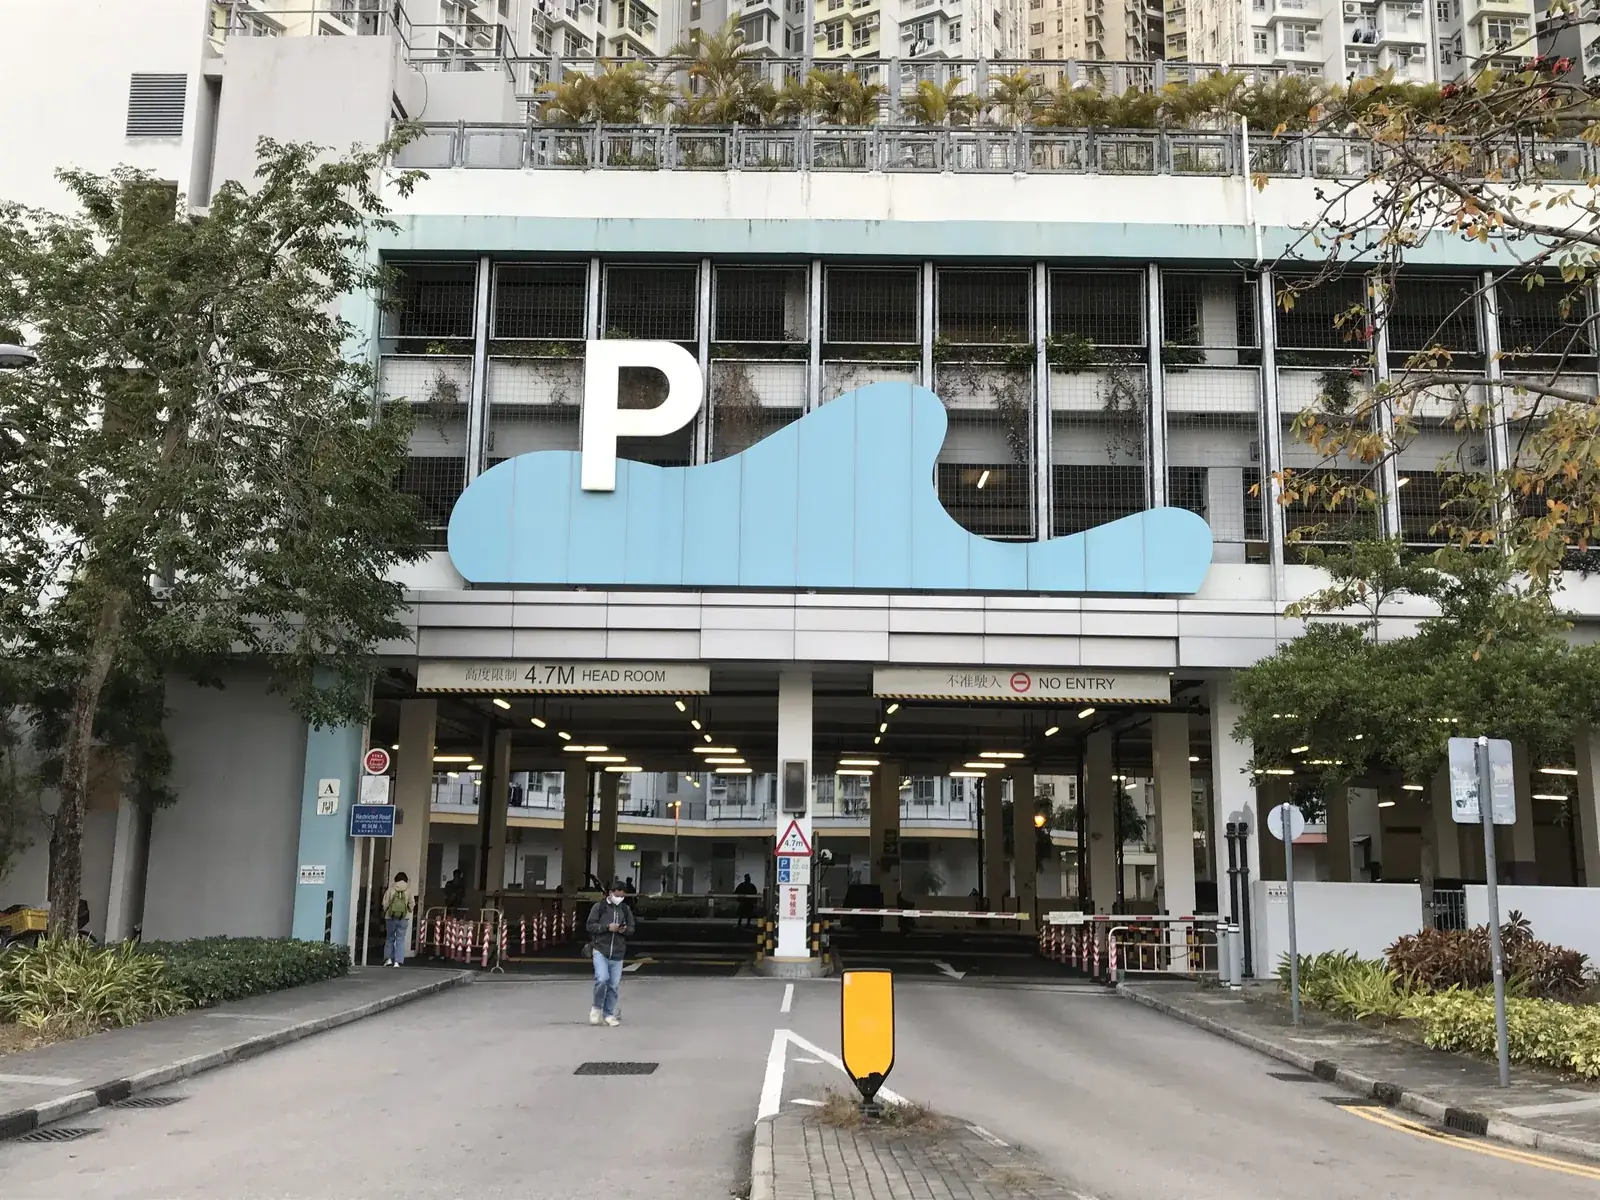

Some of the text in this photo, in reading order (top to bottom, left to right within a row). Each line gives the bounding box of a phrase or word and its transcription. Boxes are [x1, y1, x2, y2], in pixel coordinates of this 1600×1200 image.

[581, 339, 704, 492] P
[465, 665, 666, 685] 高度限制 4.7M HEAD ROOM
[946, 674, 1116, 690] 不准駛入 NO ENTRY
[324, 784, 334, 794] A
